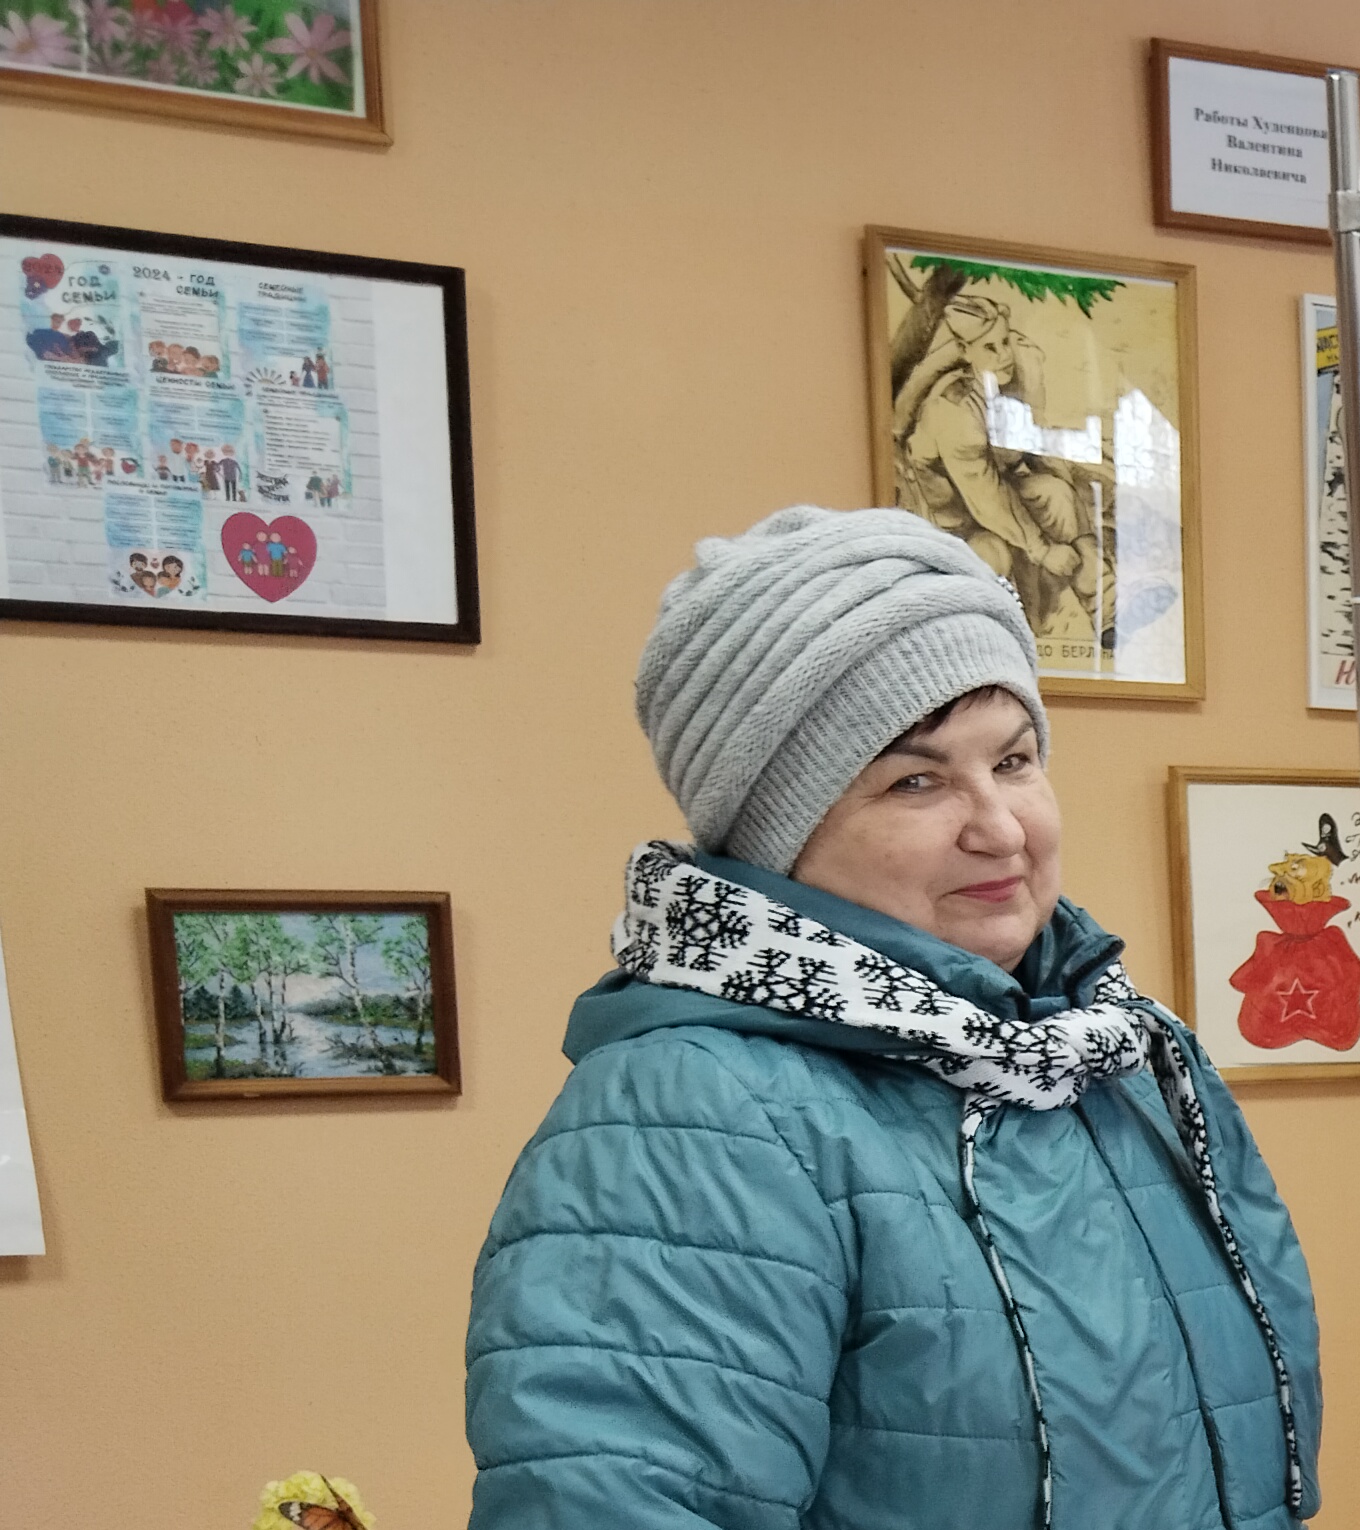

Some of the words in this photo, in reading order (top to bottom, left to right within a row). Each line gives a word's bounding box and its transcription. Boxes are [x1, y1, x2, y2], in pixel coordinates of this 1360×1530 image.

[1194, 107, 1248, 128] Работы
[1226, 135, 1303, 158] Валентина
[1211, 158, 1307, 183] Николаевича
[68, 275, 102, 288] ГОД
[132, 265, 171, 281] 2024
[190, 274, 216, 286] ГОД
[62, 290, 116, 304] СЕМЬИ
[176, 285, 219, 298] СЕМЬИ
